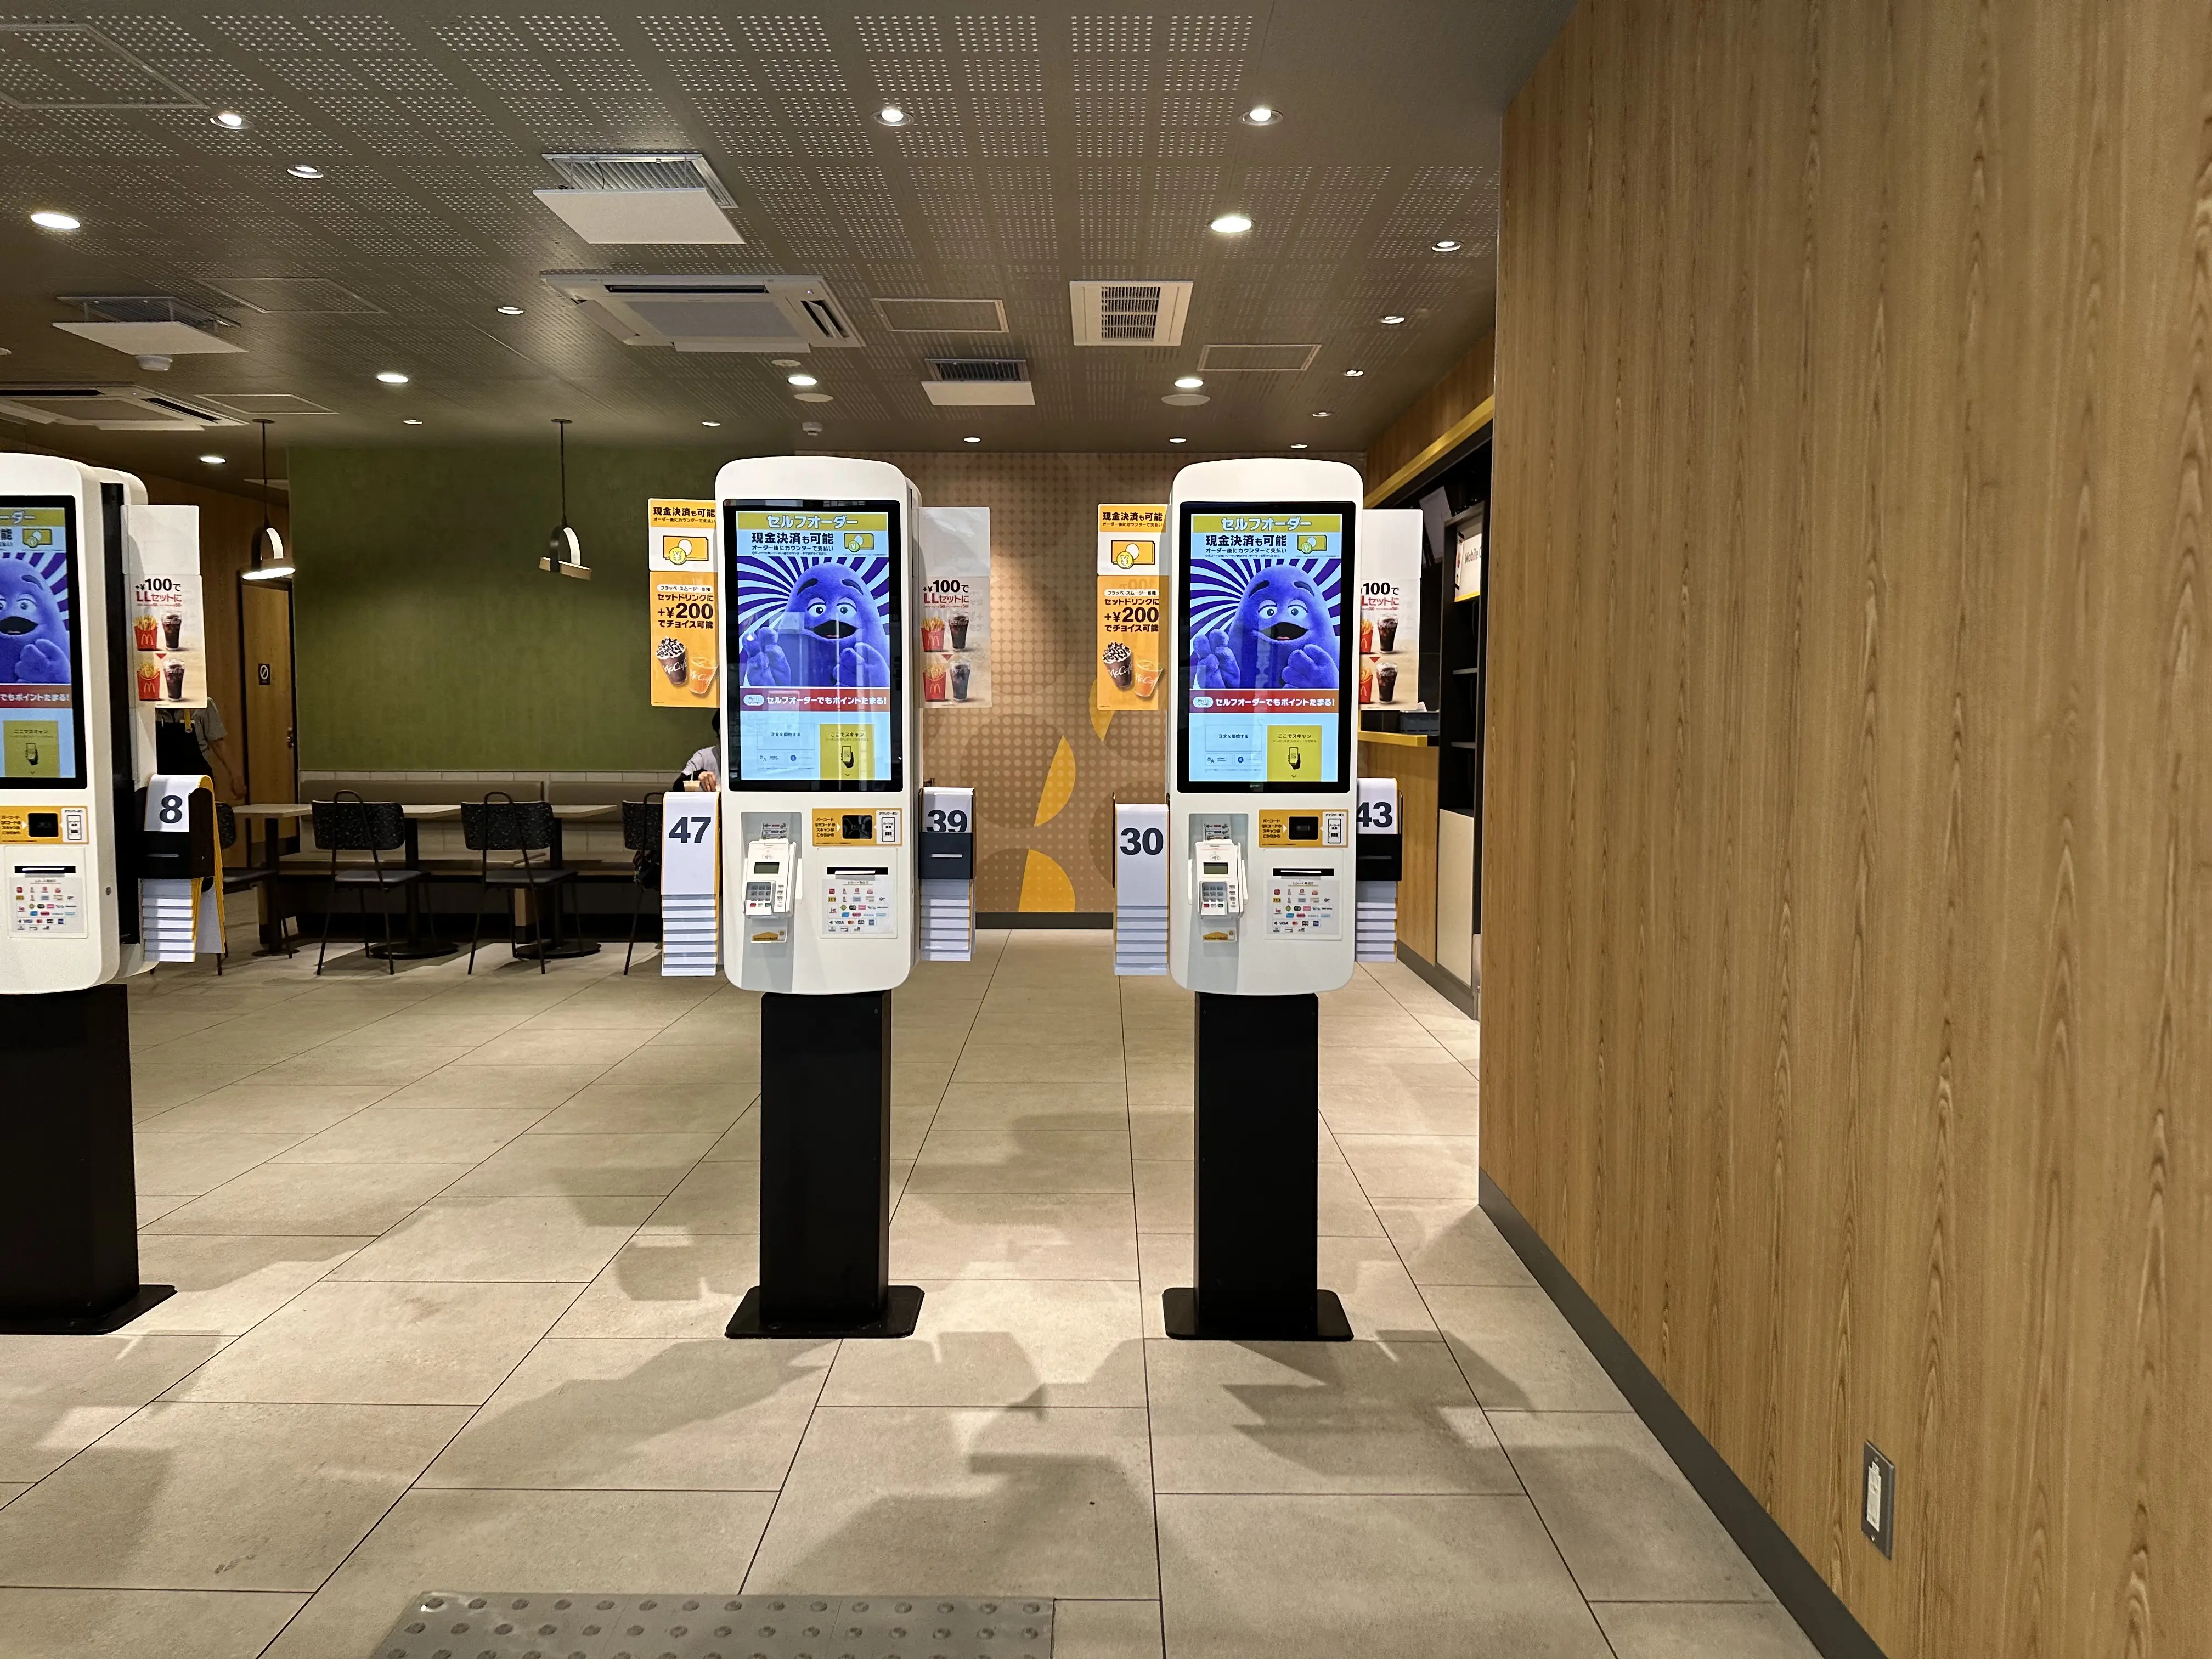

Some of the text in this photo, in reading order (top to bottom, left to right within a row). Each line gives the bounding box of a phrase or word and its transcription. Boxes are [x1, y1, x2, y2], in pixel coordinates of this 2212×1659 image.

[653, 507, 715, 517] 現金決済も可能
[1103, 512, 1163, 521] 現金決済も可能
[767, 515, 857, 529] セルフオーダー
[1221, 517, 1312, 531] セルフオーダー
[752, 532, 834, 544] 現金決済も可能
[1206, 535, 1287, 546] 現金決済も可能
[1465, 548, 1479, 564] Mobile
[136, 578, 182, 592] +¥100で
[923, 579, 969, 593] +¥100で
[136, 591, 182, 602] LLセットに
[657, 594, 714, 602] セットドリンクに
[924, 592, 969, 604] LLセットに
[657, 602, 713, 619] +¥200
[1104, 607, 1159, 623] +¥200
[658, 620, 713, 629] でチョイス可能
[767, 697, 887, 705] セルフオーダーでもポイントたまる!
[1215, 698, 1335, 707] セルフオーダーでもポイントたまる!
[159, 795, 183, 823] 8
[1356, 802, 1393, 827] 43
[926, 809, 968, 832] 39
[668, 816, 712, 843] 47
[1120, 828, 1164, 855] 30
